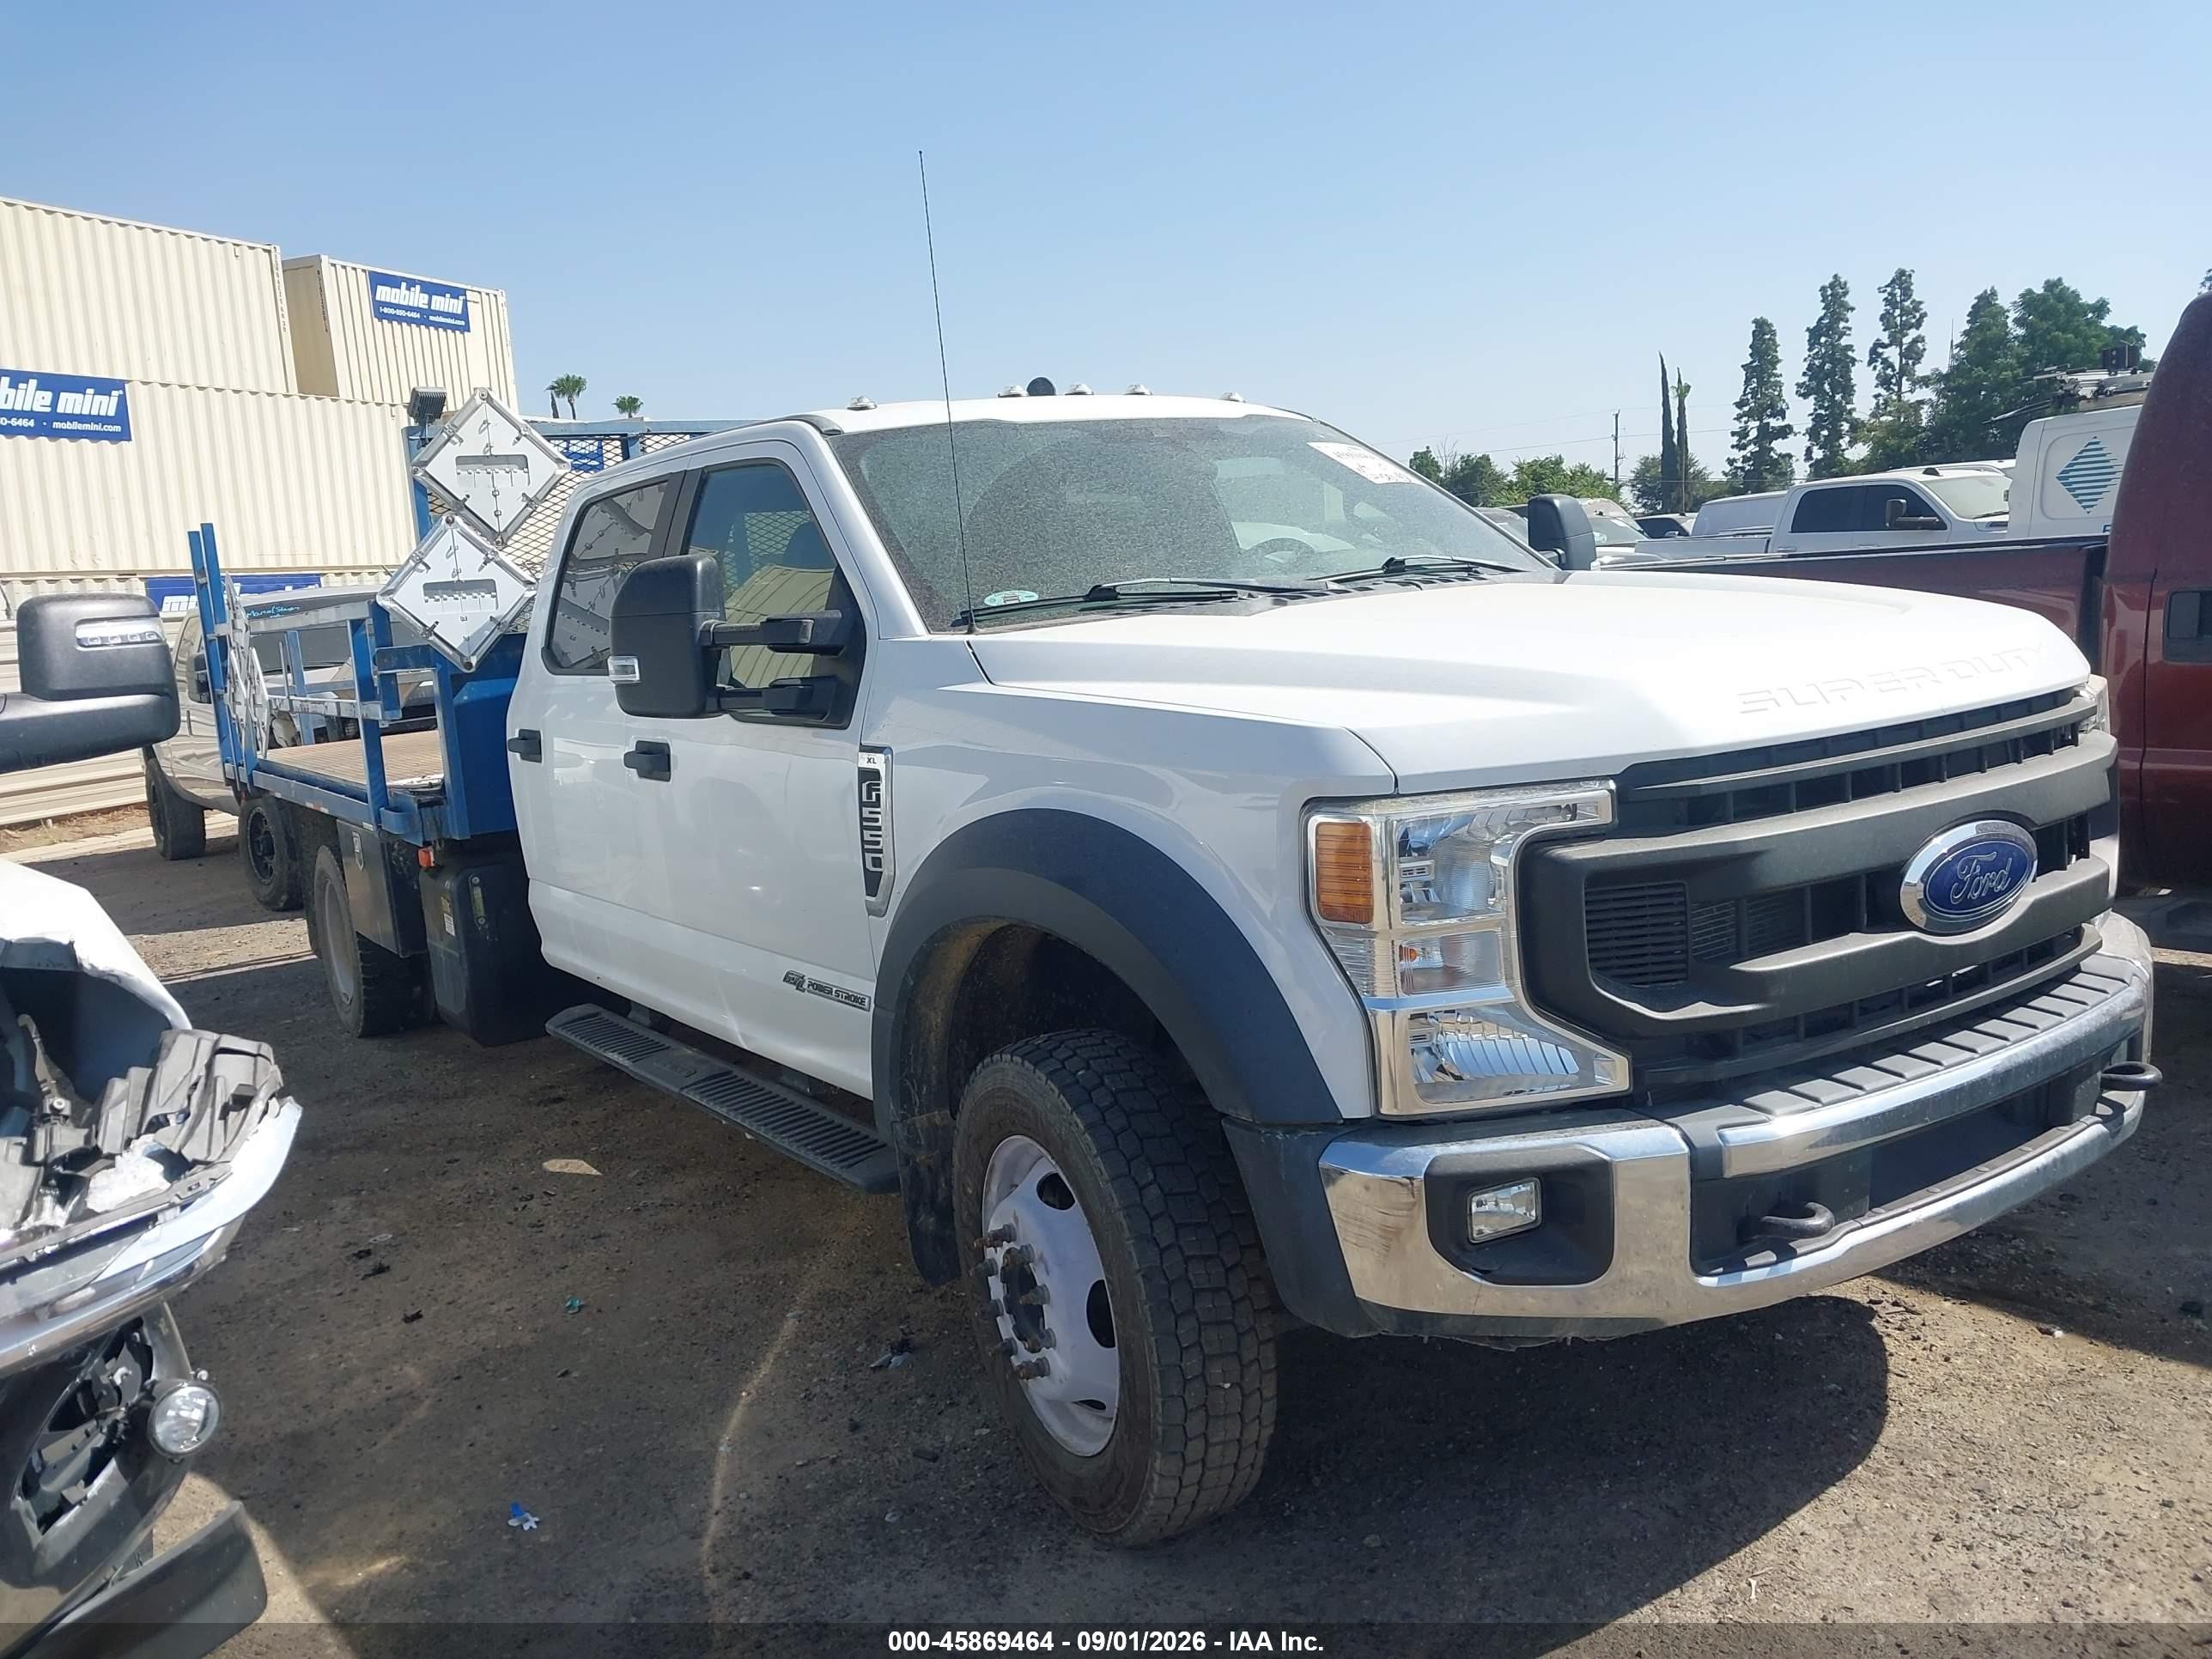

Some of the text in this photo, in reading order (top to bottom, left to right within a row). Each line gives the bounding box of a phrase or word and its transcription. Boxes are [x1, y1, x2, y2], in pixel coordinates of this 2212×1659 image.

[375, 281, 465, 315] mobile mini
[0, 376, 119, 416] bile mini
[0, 416, 122, 433] 0-6464 mobilemini.com
[1738, 643, 2049, 714] SUPER DUTY
[1950, 851, 2013, 905] Ford
[806, 981, 834, 996] POWER
[834, 989, 866, 1006] STROKE
